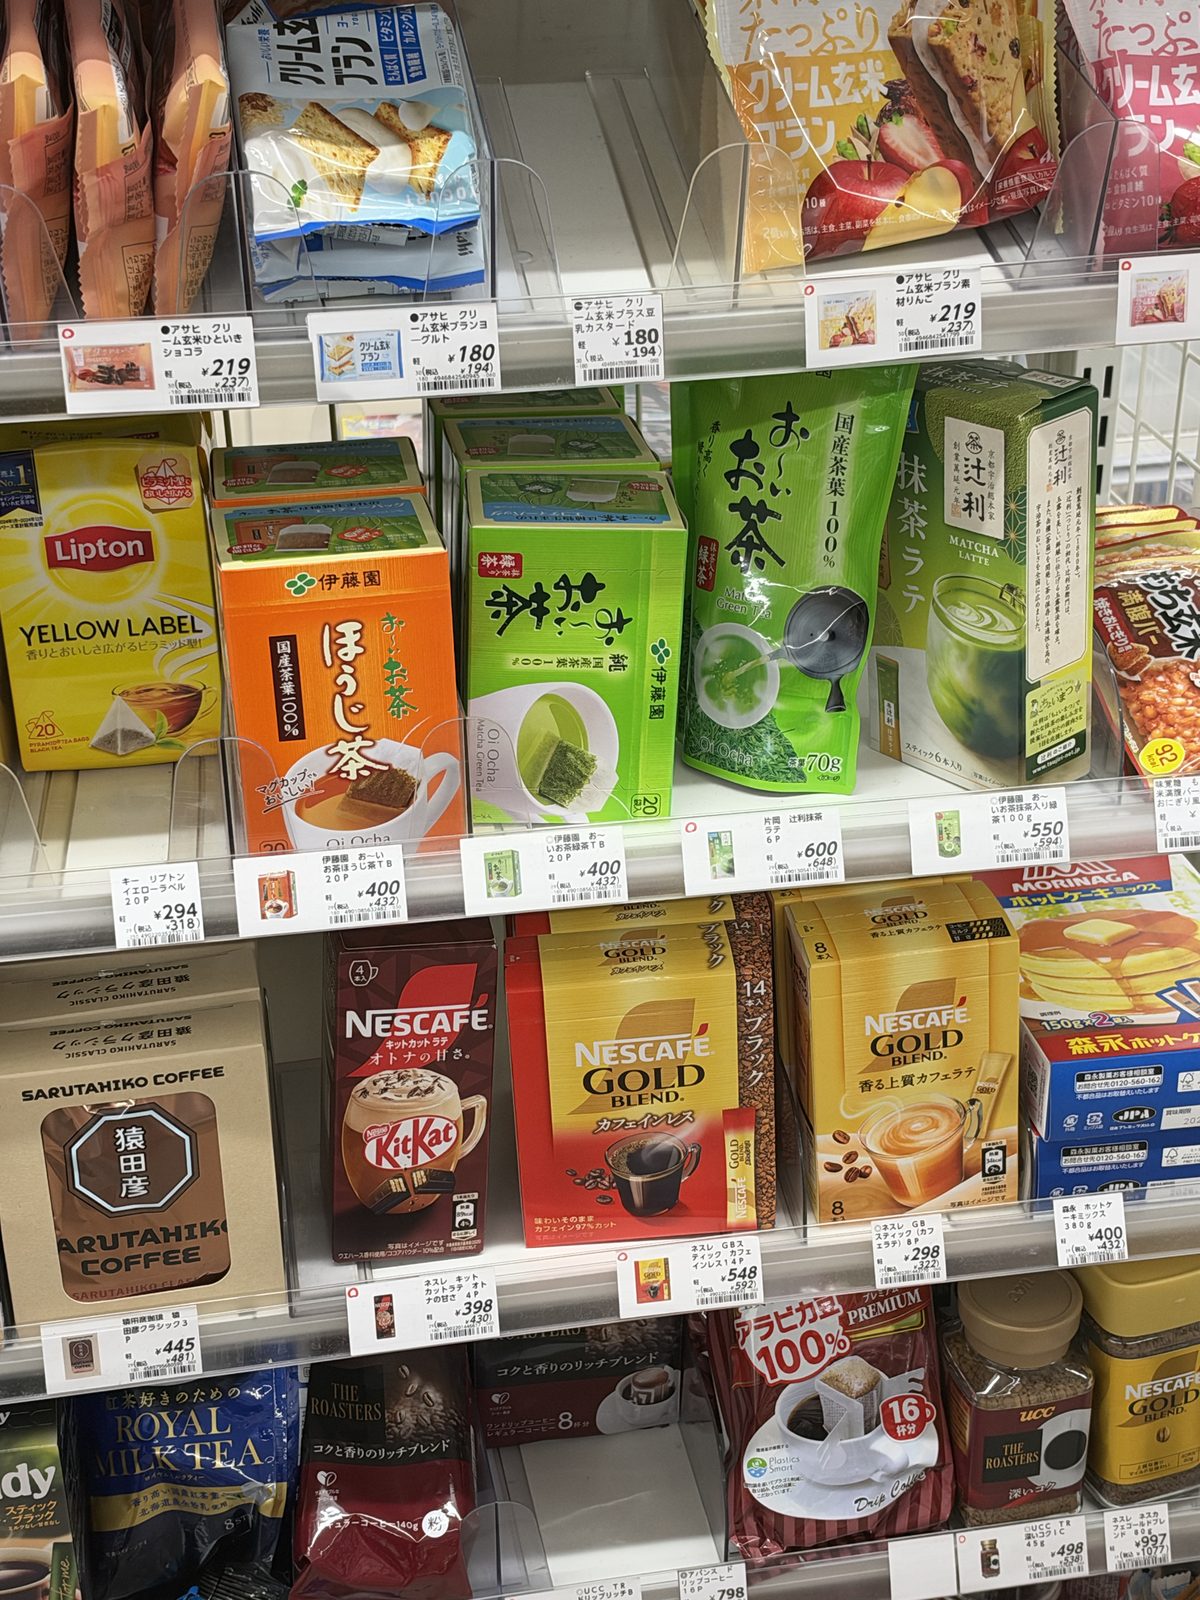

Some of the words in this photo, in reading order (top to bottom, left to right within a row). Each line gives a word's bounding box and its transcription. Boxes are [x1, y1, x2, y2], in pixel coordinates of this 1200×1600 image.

[747, 58, 887, 115] クリーム玄米
[760, 117, 837, 161] ブラン
[905, 273, 932, 284] アサヒ
[943, 269, 960, 280] クリ
[625, 297, 643, 308] クリ
[896, 294, 934, 308] 材りんご
[419, 312, 448, 322] アサヒ
[459, 310, 478, 320] クリ
[170, 324, 201, 336] アサヒ
[212, 323, 231, 333] クリ
[410, 320, 488, 334] ーム玄米ブランヨ
[575, 319, 635, 334] 乳カスタード
[161, 334, 243, 347] ーム玄米ひといき
[410, 333, 451, 345] ーグルト
[163, 347, 203, 359] ショコラ
[724, 428, 786, 574] お茶
[896, 451, 929, 615] 抹茶ラテ
[54, 536, 146, 566] Lipton
[949, 534, 1000, 559] MATCHA
[959, 549, 990, 568] LATTE
[318, 570, 382, 592] 伊藤園
[484, 571, 607, 639] お茶
[716, 597, 747, 615] Green
[18, 618, 120, 647] YELLOW
[127, 614, 204, 637] LABEL
[322, 620, 391, 782] ほうじ茶
[648, 665, 668, 722] 伊藤園
[35, 723, 56, 739] 20
[719, 742, 754, 766] Ocha
[1154, 743, 1178, 767] 92
[485, 749, 500, 784] Ocha
[640, 796, 658, 816] 20
[764, 825, 781, 836] ラテ
[121, 877, 139, 886] キー
[122, 883, 186, 897] イエローラベル
[1011, 869, 1140, 895] MORINAGA
[1010, 882, 1161, 907] ホットケーキミックス
[870, 909, 928, 926] GOLD
[603, 945, 667, 959] GOLD
[700, 921, 725, 970] ブラック
[814, 941, 828, 954] 8
[815, 951, 834, 962] 本入
[741, 979, 767, 997] 14
[385, 1037, 432, 1049] キットカット
[432, 1035, 449, 1047] ラテ
[744, 1013, 768, 1090] ブラック
[869, 1028, 964, 1058] GOLD
[21, 1076, 147, 1103] SARUTAHIKO
[152, 1064, 226, 1087] COFFEE
[582, 1062, 706, 1097] GOLD
[858, 1065, 977, 1094] 香る上質カフェラテ
[593, 1109, 696, 1136] カフェインレス
[1118, 1108, 1151, 1122] JPA
[375, 1114, 455, 1170] KitKat
[114, 1125, 149, 1200] 猿田彦
[729, 1138, 741, 1170] GOLD
[831, 1200, 845, 1217] 8
[875, 1229, 912, 1241] スティック
[691, 1243, 714, 1254] ネスレ
[691, 1251, 722, 1263] ティック
[729, 1248, 752, 1258] カフェ
[81, 1245, 202, 1277] COFFEE
[424, 1278, 448, 1288] ネスレ
[456, 1273, 479, 1283] キット
[425, 1284, 464, 1296] カットラテ
[425, 1294, 456, 1305] ナの甘さ
[846, 1287, 923, 1327] PREMIUM
[734, 1296, 843, 1347] アラビカ豆
[496, 1351, 660, 1378] コクと香りのリッチブレンド
[756, 1328, 852, 1382] 100%
[330, 1382, 360, 1402] THE
[310, 1397, 383, 1422] ROASTERS
[888, 1397, 921, 1419] 16
[1128, 1388, 1200, 1417] GOLD
[116, 1405, 232, 1444] ROYAL
[896, 1423, 918, 1438] 杯分
[97, 1446, 181, 1479] MILK
[183, 1438, 266, 1473] TEA
[312, 1438, 451, 1461] コクと香りのリッチブレンド
[1002, 1441, 1025, 1456] THE
[768, 1456, 801, 1466] Plastics
[769, 1463, 793, 1474] Smart
[985, 1450, 1041, 1471] ROASTERS
[1008, 1481, 1058, 1501] 深いコク
[5, 1500, 57, 1517] スティック
[854, 1496, 887, 1514] Drip
[11, 1510, 54, 1525] ブラック
[427, 1515, 443, 1532] 粉
